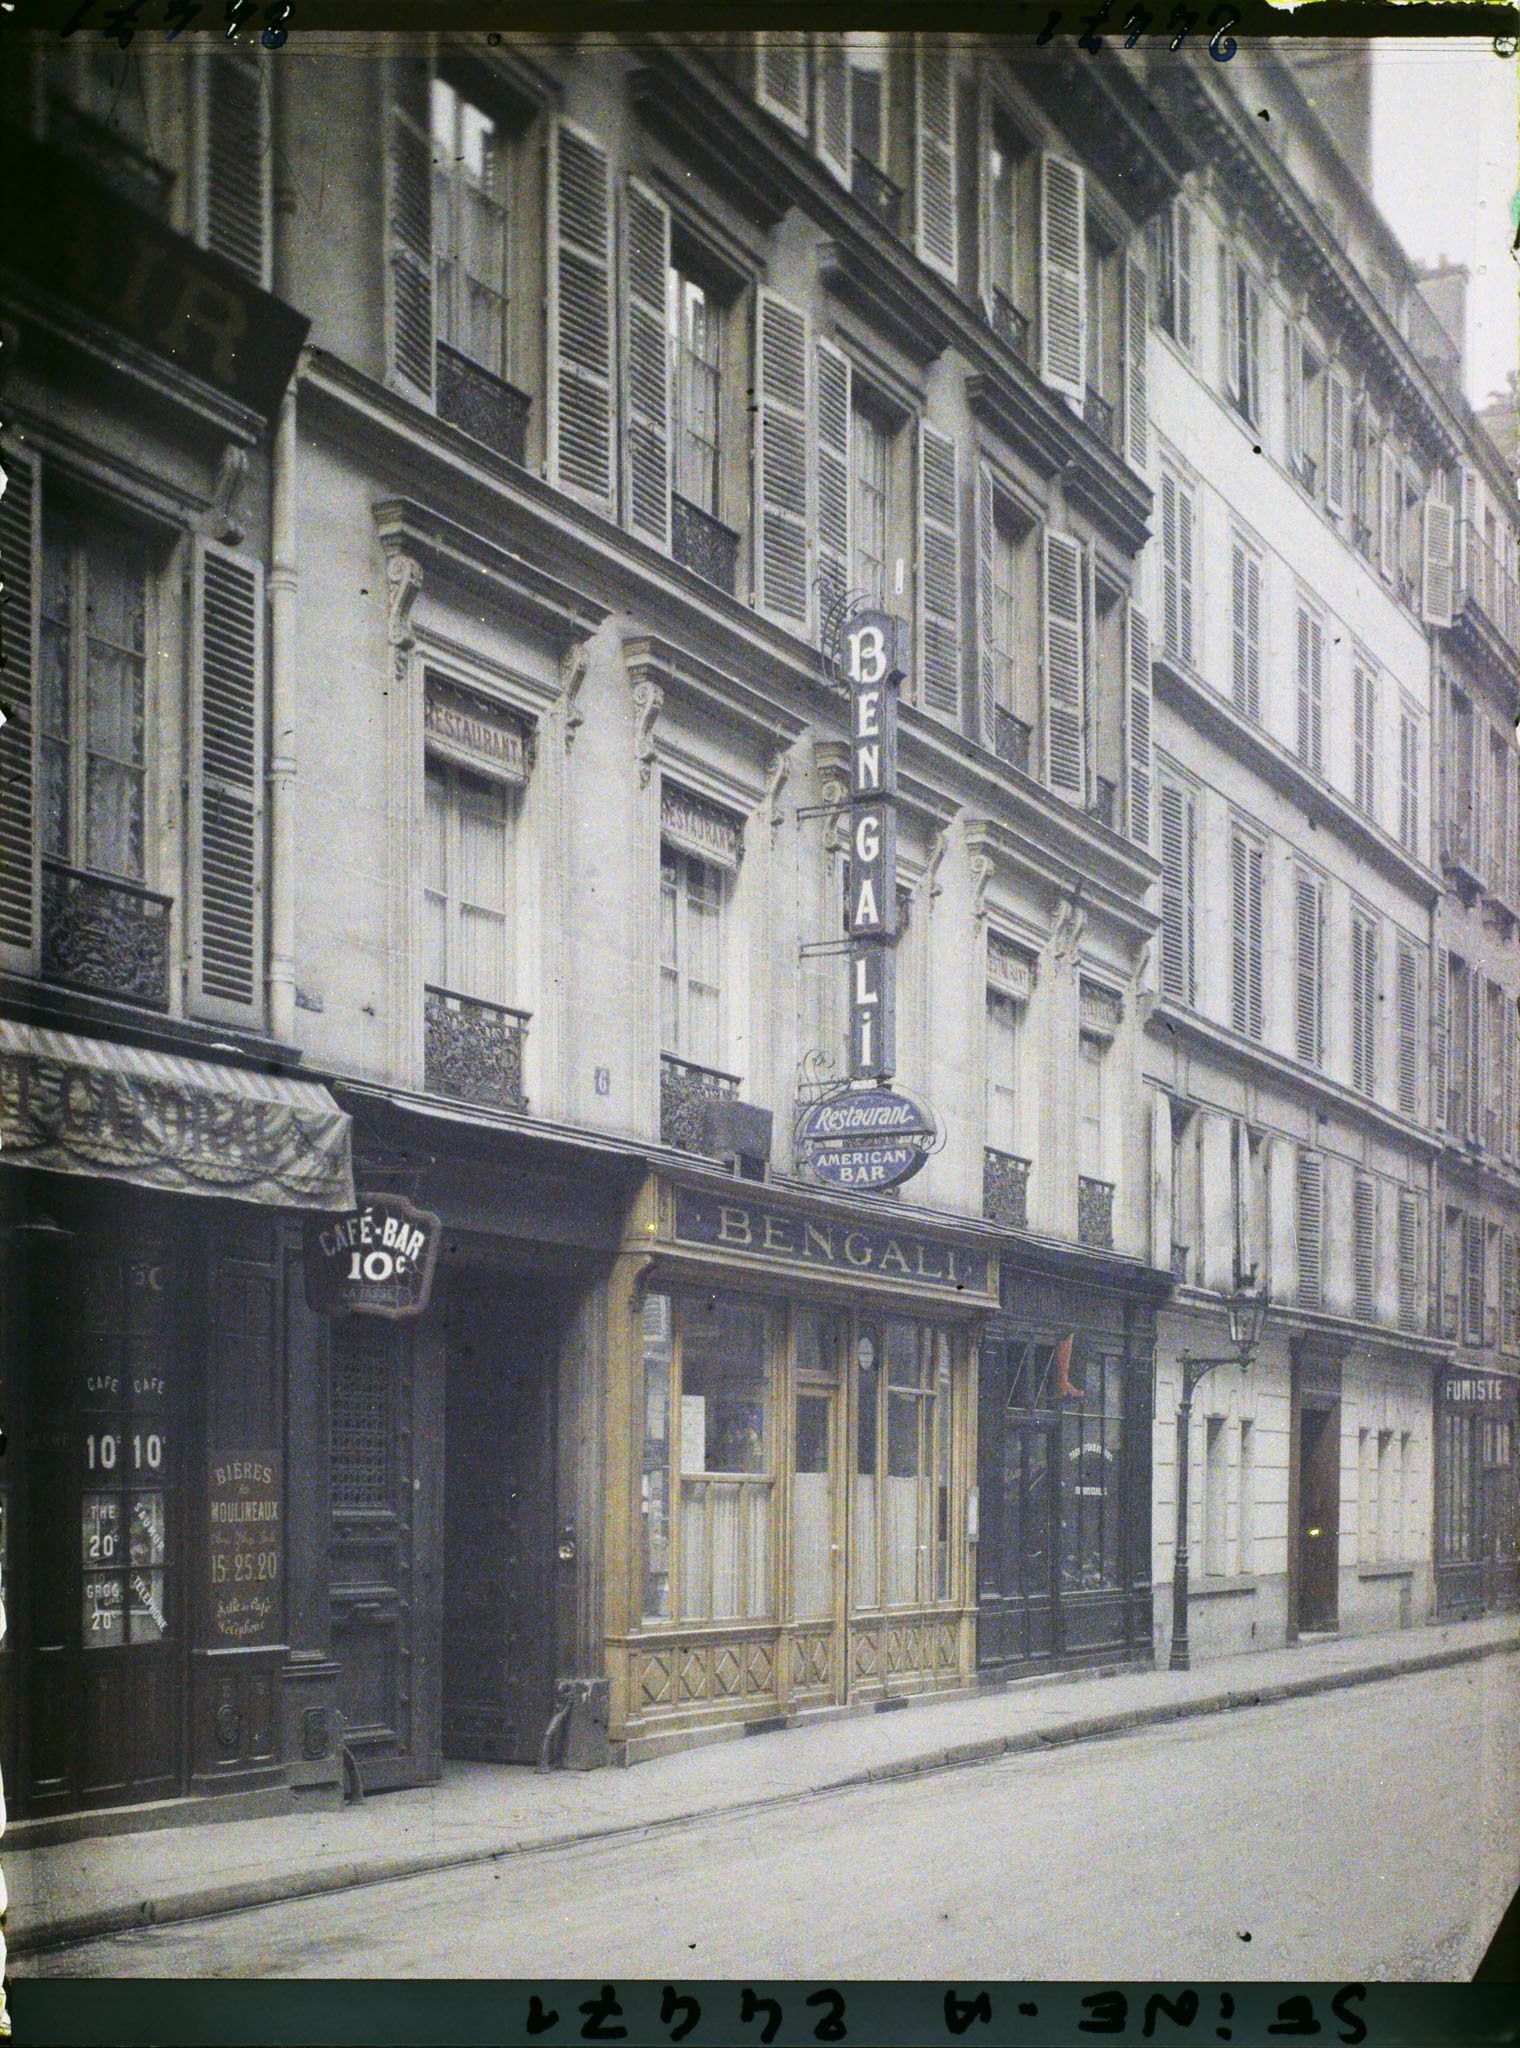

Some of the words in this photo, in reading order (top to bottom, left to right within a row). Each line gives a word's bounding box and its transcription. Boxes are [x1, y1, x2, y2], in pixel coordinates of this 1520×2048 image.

[815, 1103, 914, 1132] Restaurant
[816, 1149, 907, 1167] AMERICAN
[840, 1166, 885, 1182] BAR
[319, 1206, 425, 1261] CAFÉ-BAR
[86, 1583, 119, 1599] GROG
[526, 1984, 848, 2044] 24471
